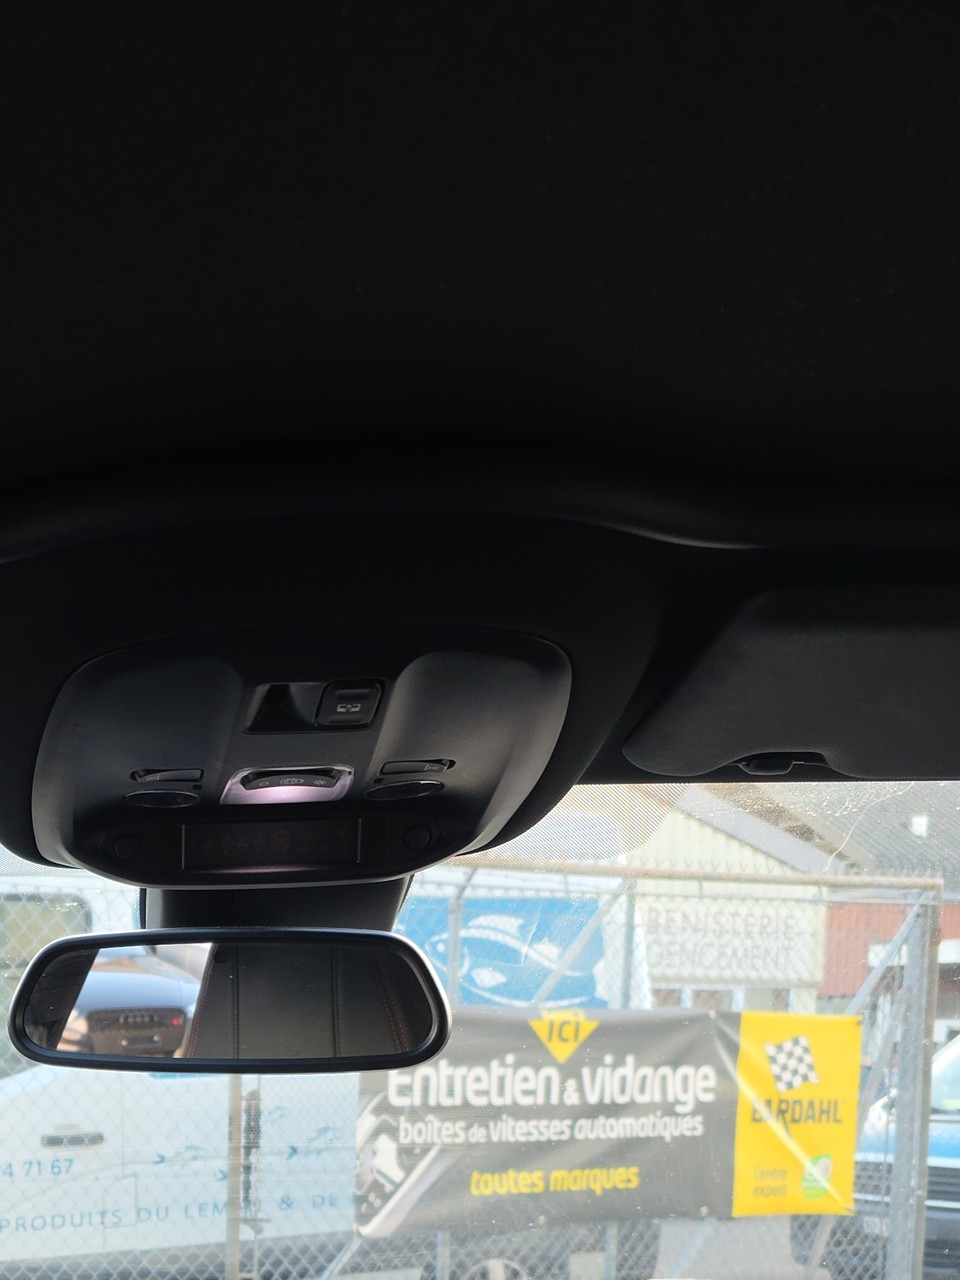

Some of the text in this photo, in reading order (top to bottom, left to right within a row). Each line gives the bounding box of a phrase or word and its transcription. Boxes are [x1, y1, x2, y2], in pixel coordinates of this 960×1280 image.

[647, 907, 796, 940] BENISTERIE
[645, 940, 793, 970] GENCEMENT
[548, 1020, 580, 1042] ICI
[388, 1053, 717, 1114] Entretien & vidange
[399, 1111, 704, 1144] boîtes de vitesses automatiques
[23, 1160, 43, 1178] 71
[50, 1158, 74, 1176] 67
[470, 1166, 639, 1197] toutes marques
[136, 1206, 170, 1223] DU
